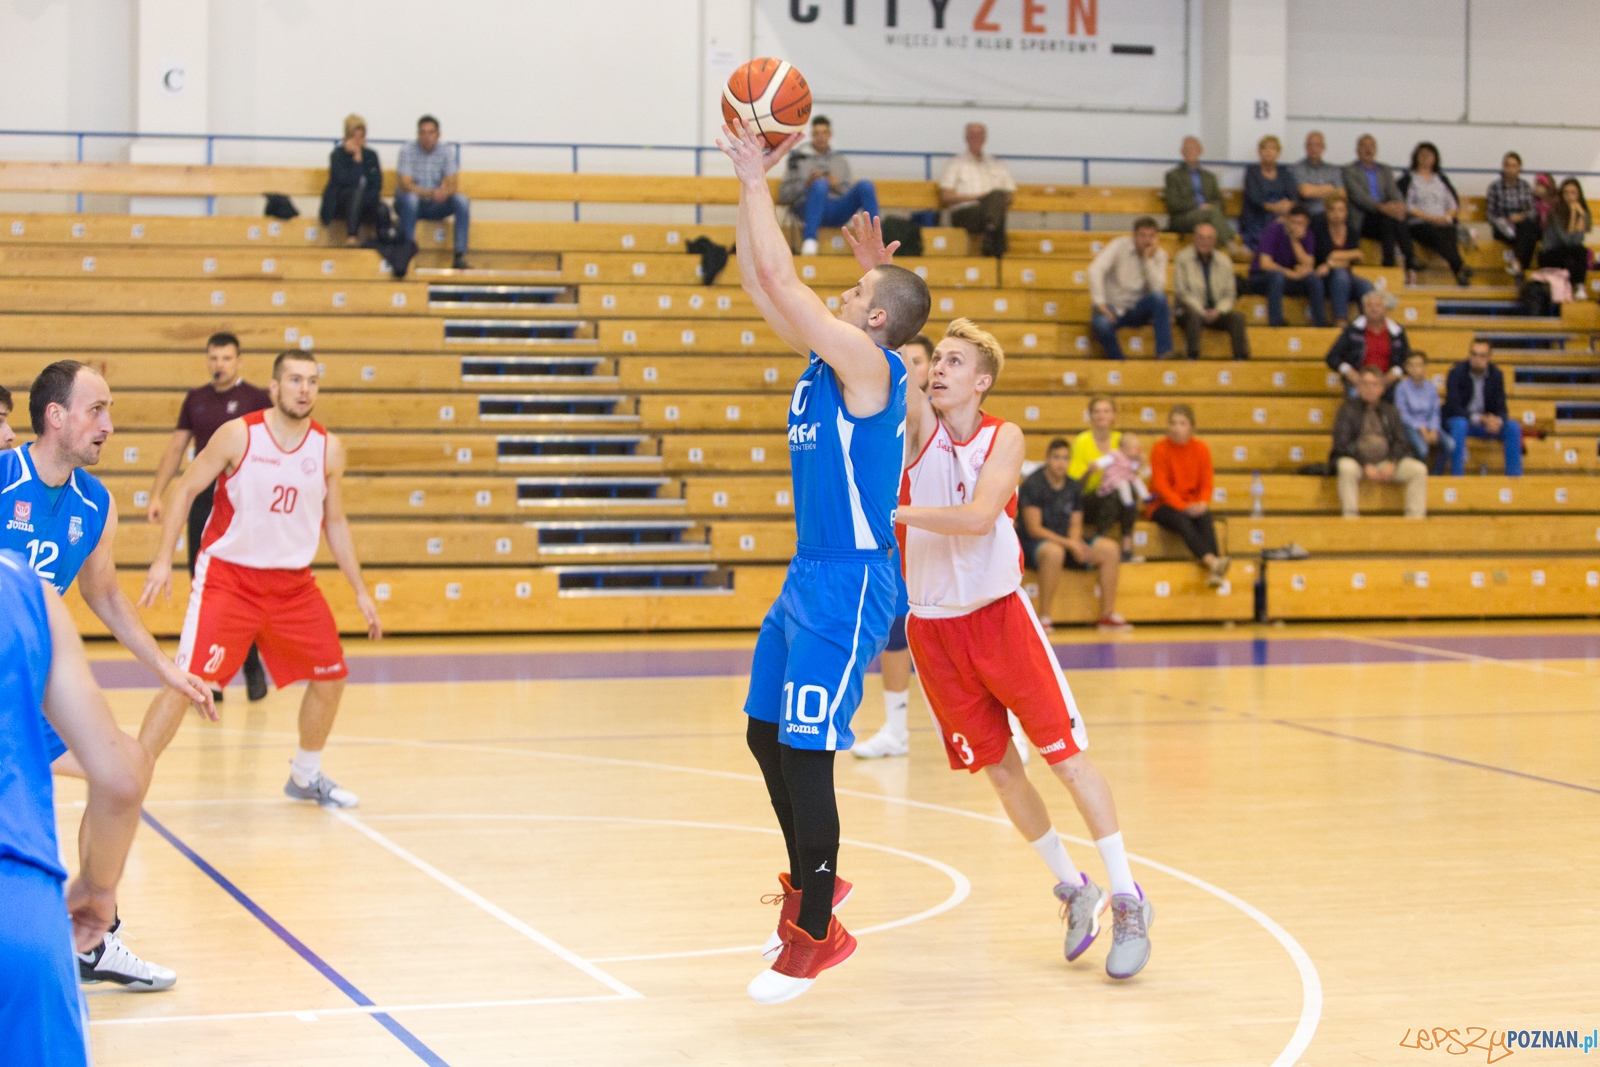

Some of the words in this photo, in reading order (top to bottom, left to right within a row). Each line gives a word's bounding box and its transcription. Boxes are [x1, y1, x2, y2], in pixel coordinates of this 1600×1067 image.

[975, 38, 1013, 51] KLUB
[1020, 39, 1098, 54] SPORTOWY
[164, 68, 185, 92] C
[1254, 99, 1270, 120] B
[270, 485, 298, 514] 20
[26, 539, 59, 579] 12
[203, 643, 226, 674] 20
[784, 681, 828, 724] 10
[952, 732, 975, 765] 3
